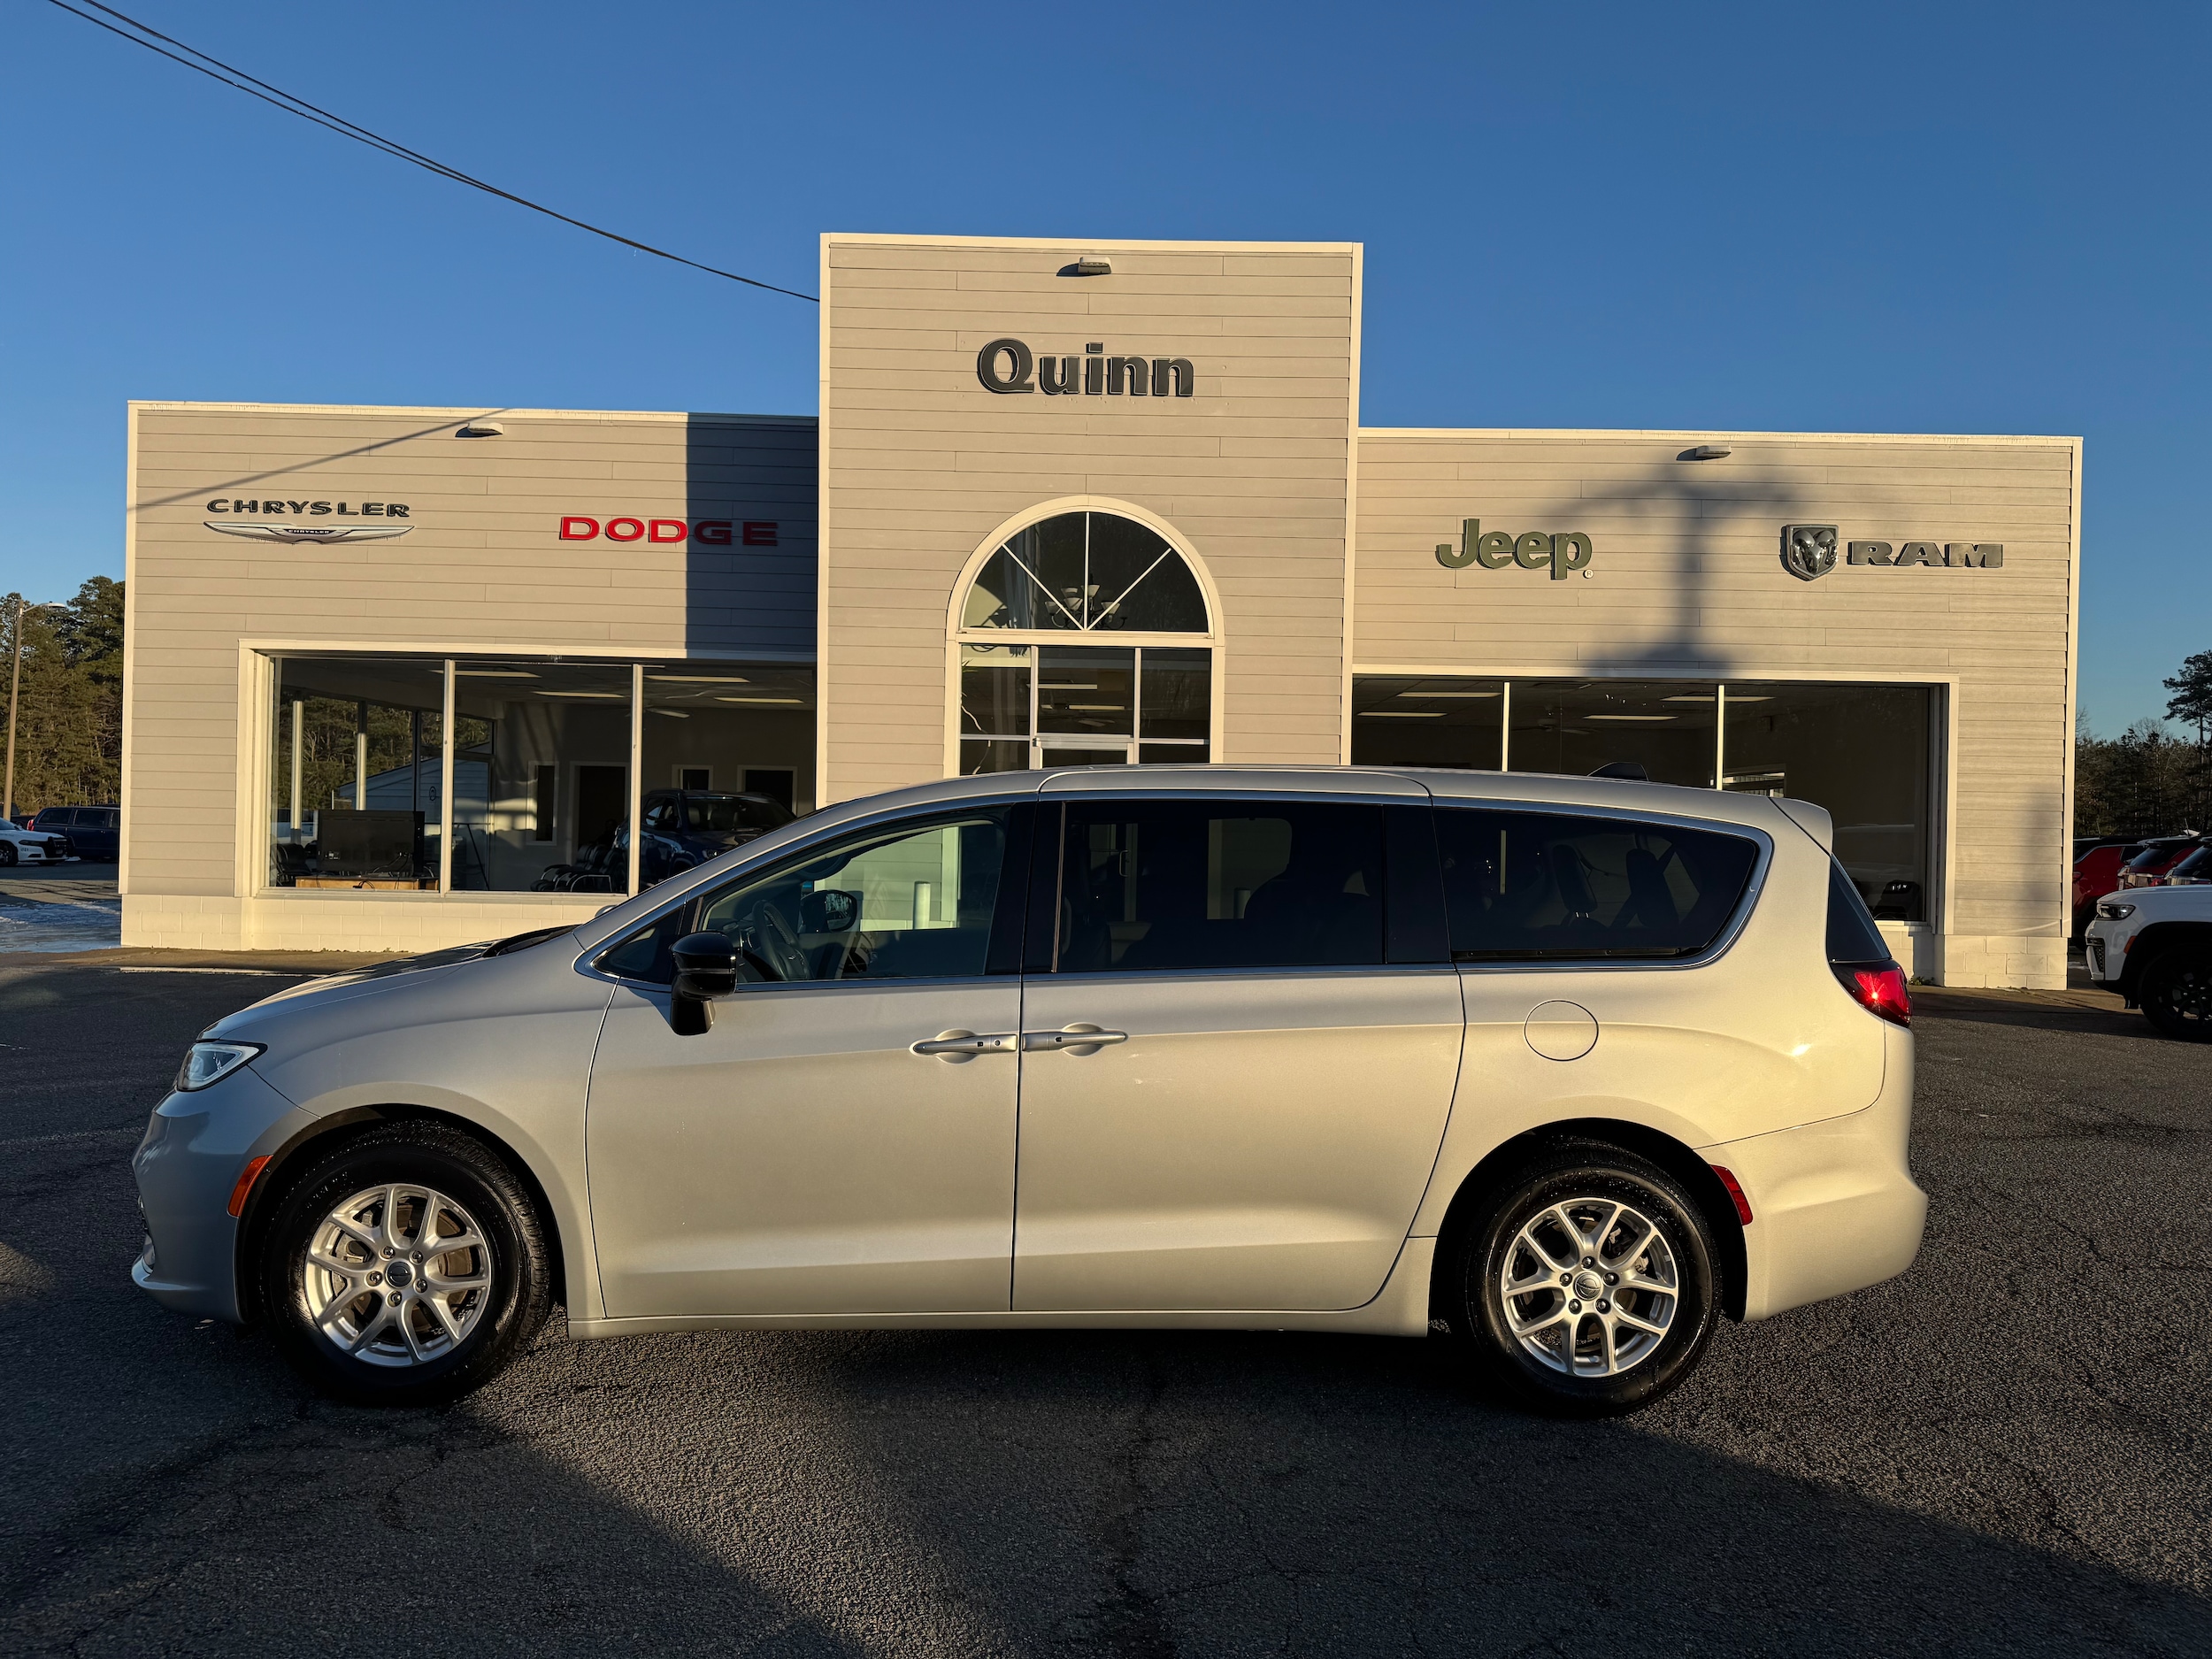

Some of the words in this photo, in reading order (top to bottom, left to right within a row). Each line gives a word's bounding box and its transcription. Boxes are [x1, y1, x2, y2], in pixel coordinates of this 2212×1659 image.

[977, 338, 1194, 396] Quinn
[207, 499, 410, 517] CHRYSLER
[559, 517, 778, 546] DODGE
[1435, 518, 1592, 580] Jeep
[1847, 541, 2003, 568] RAM
